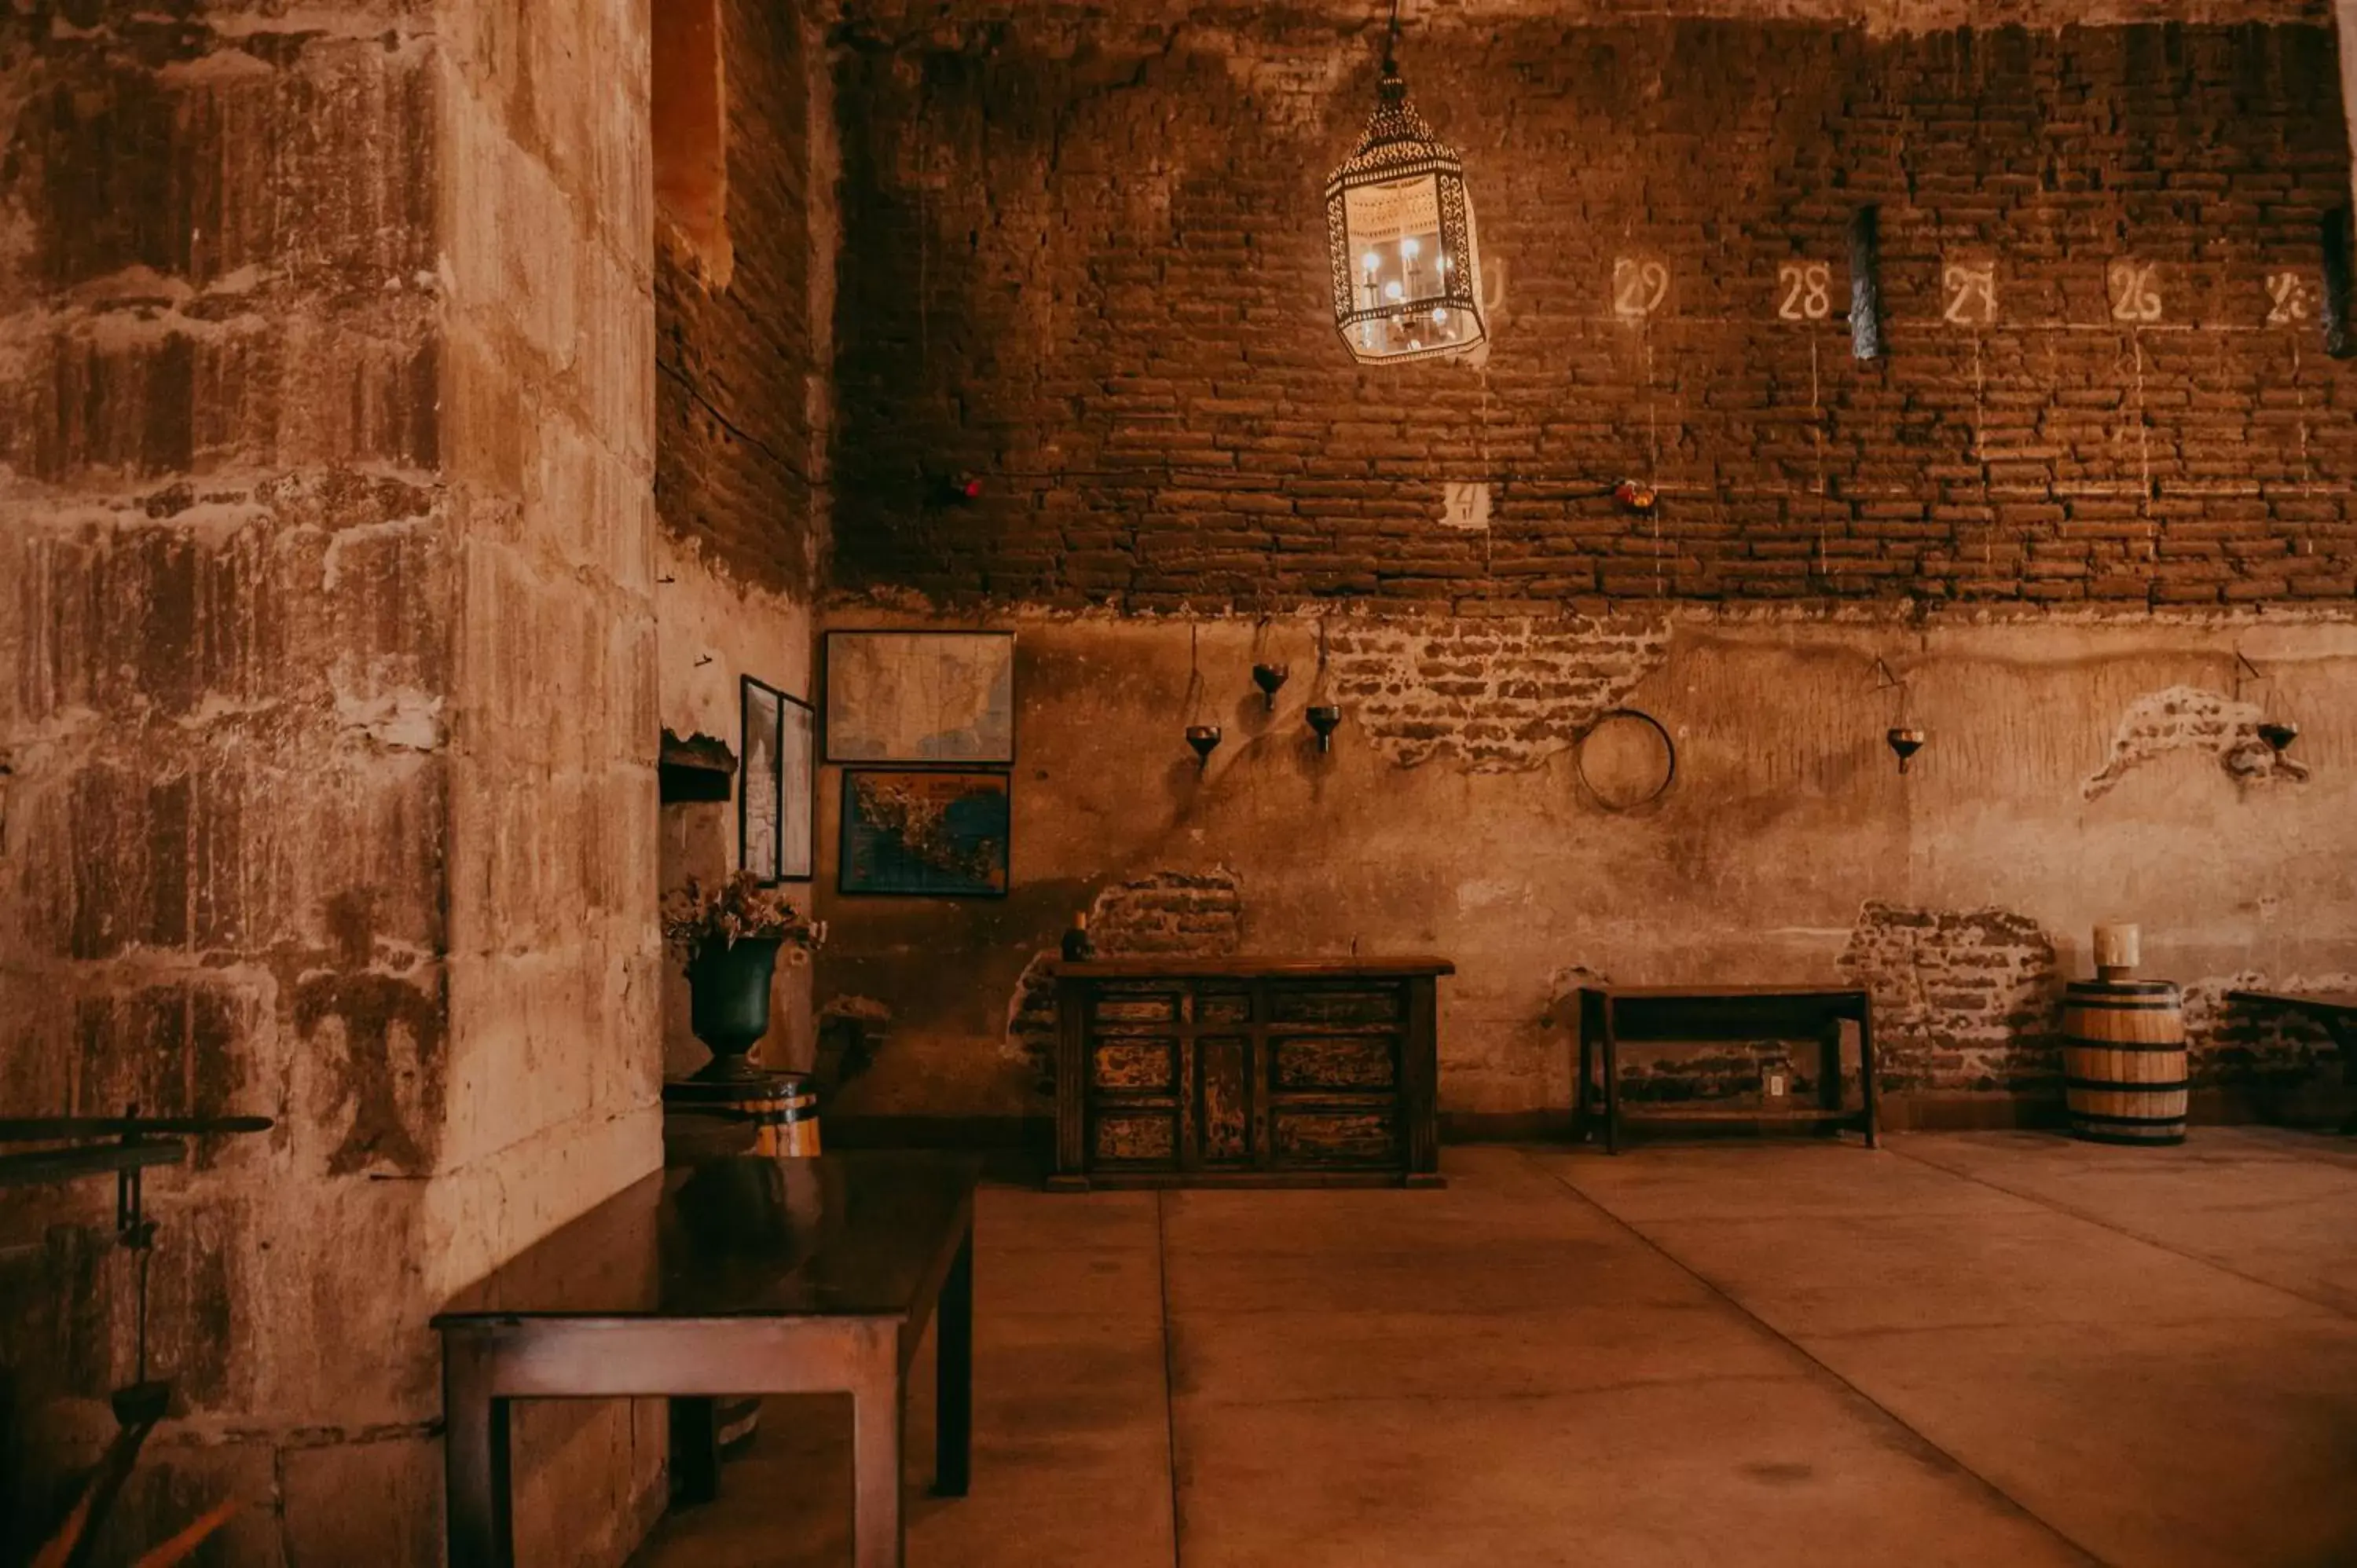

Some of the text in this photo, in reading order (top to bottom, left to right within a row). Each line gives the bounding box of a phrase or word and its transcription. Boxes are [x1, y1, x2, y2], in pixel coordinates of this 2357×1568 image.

[1615, 259, 1667, 315] 29
[1779, 265, 1830, 320] 28
[1945, 266, 1997, 323] 27
[2112, 262, 2162, 321] 26
